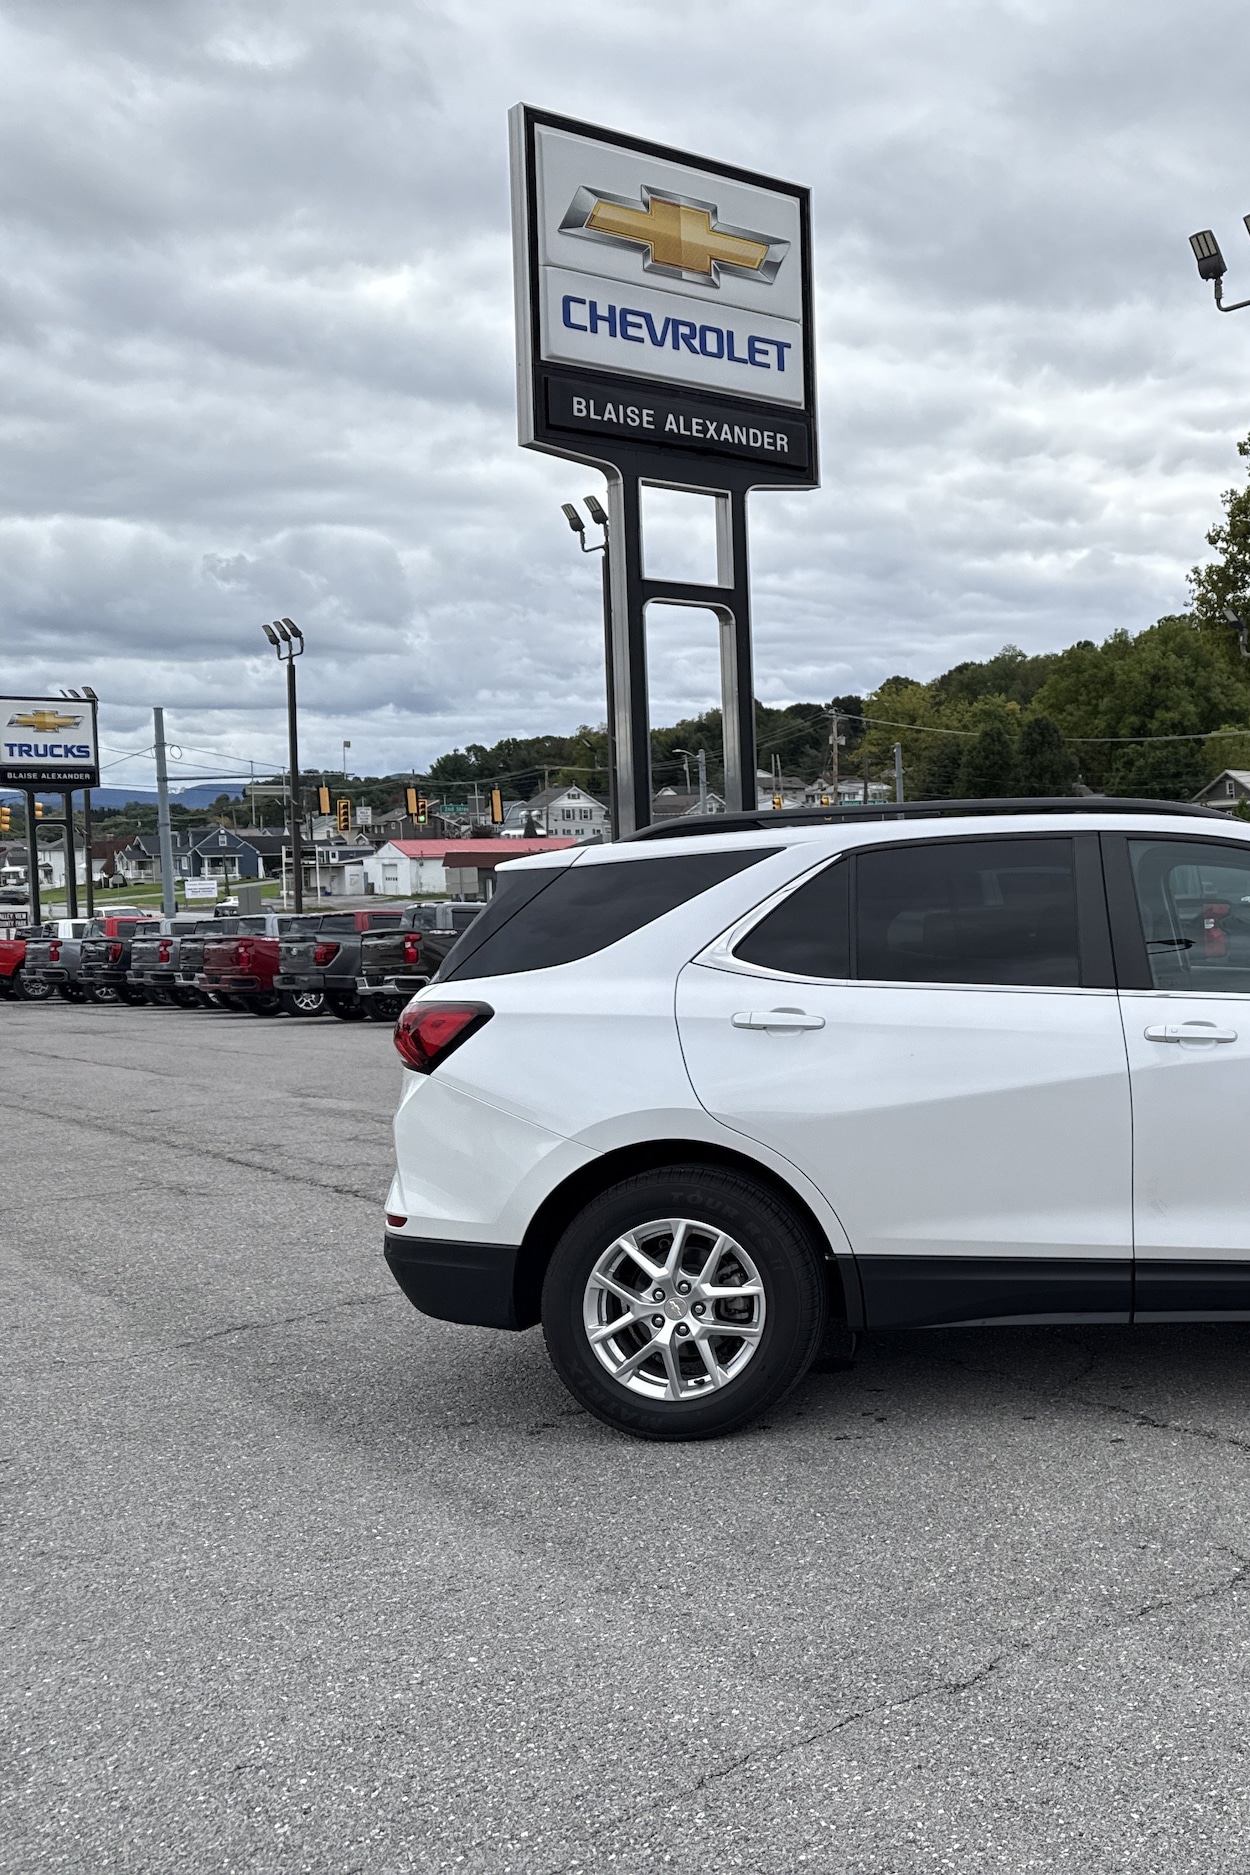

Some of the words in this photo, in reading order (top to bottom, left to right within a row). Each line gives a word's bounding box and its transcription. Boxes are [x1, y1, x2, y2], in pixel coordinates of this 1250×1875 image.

[562, 294, 792, 372] CHEVROLET
[572, 396, 655, 430] BLAISE
[664, 413, 789, 453] ALEXANDER
[4, 743, 90, 758] TRUCKS
[6, 772, 38, 780] BLAISE
[41, 772, 91, 780] ALEXANDER
